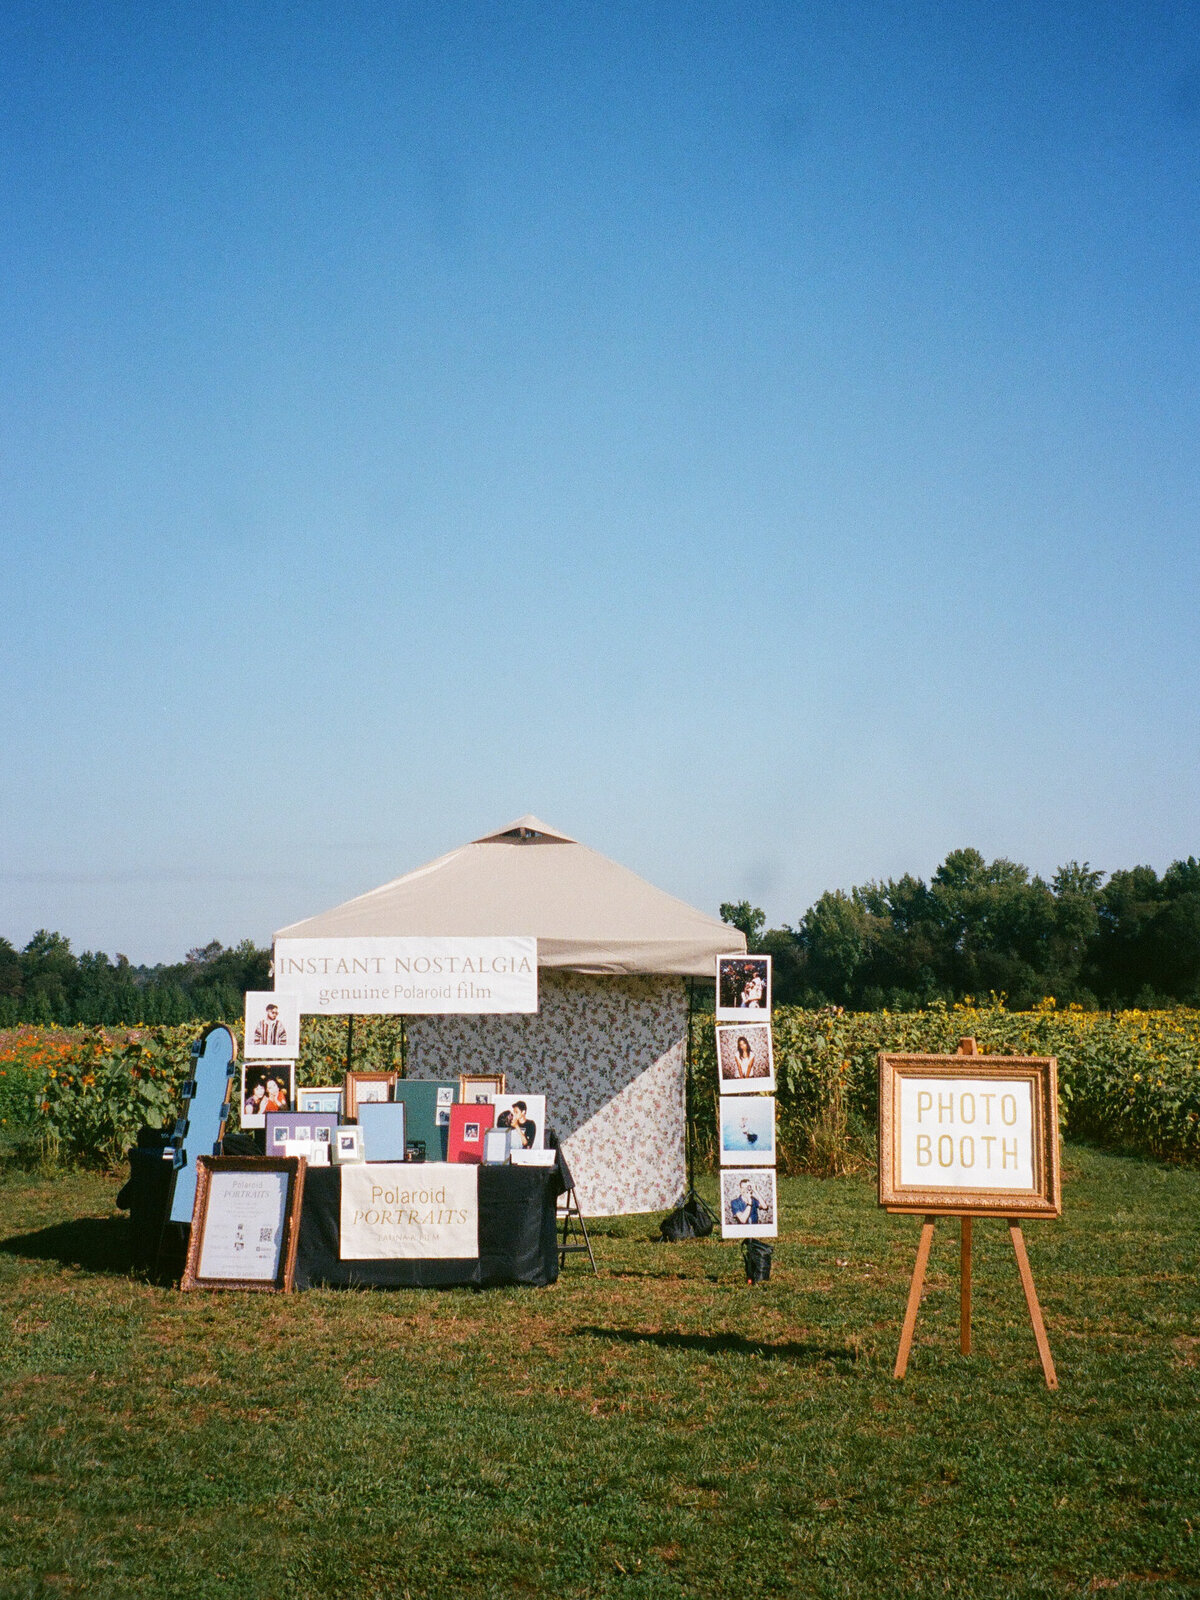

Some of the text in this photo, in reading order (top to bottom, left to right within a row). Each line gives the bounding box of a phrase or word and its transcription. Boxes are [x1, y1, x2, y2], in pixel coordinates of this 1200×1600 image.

[280, 956, 533, 975] INSTANT NOSTALGIA
[319, 981, 492, 1006] genuine Polaroid film
[917, 1090, 1017, 1126] PHOTO
[916, 1134, 1019, 1170] BOOTH
[232, 1180, 263, 1189] Polaroid
[223, 1190, 270, 1199] PORTRAITS
[371, 1185, 446, 1204] Polaroid
[353, 1209, 468, 1225] PORTRAITS
